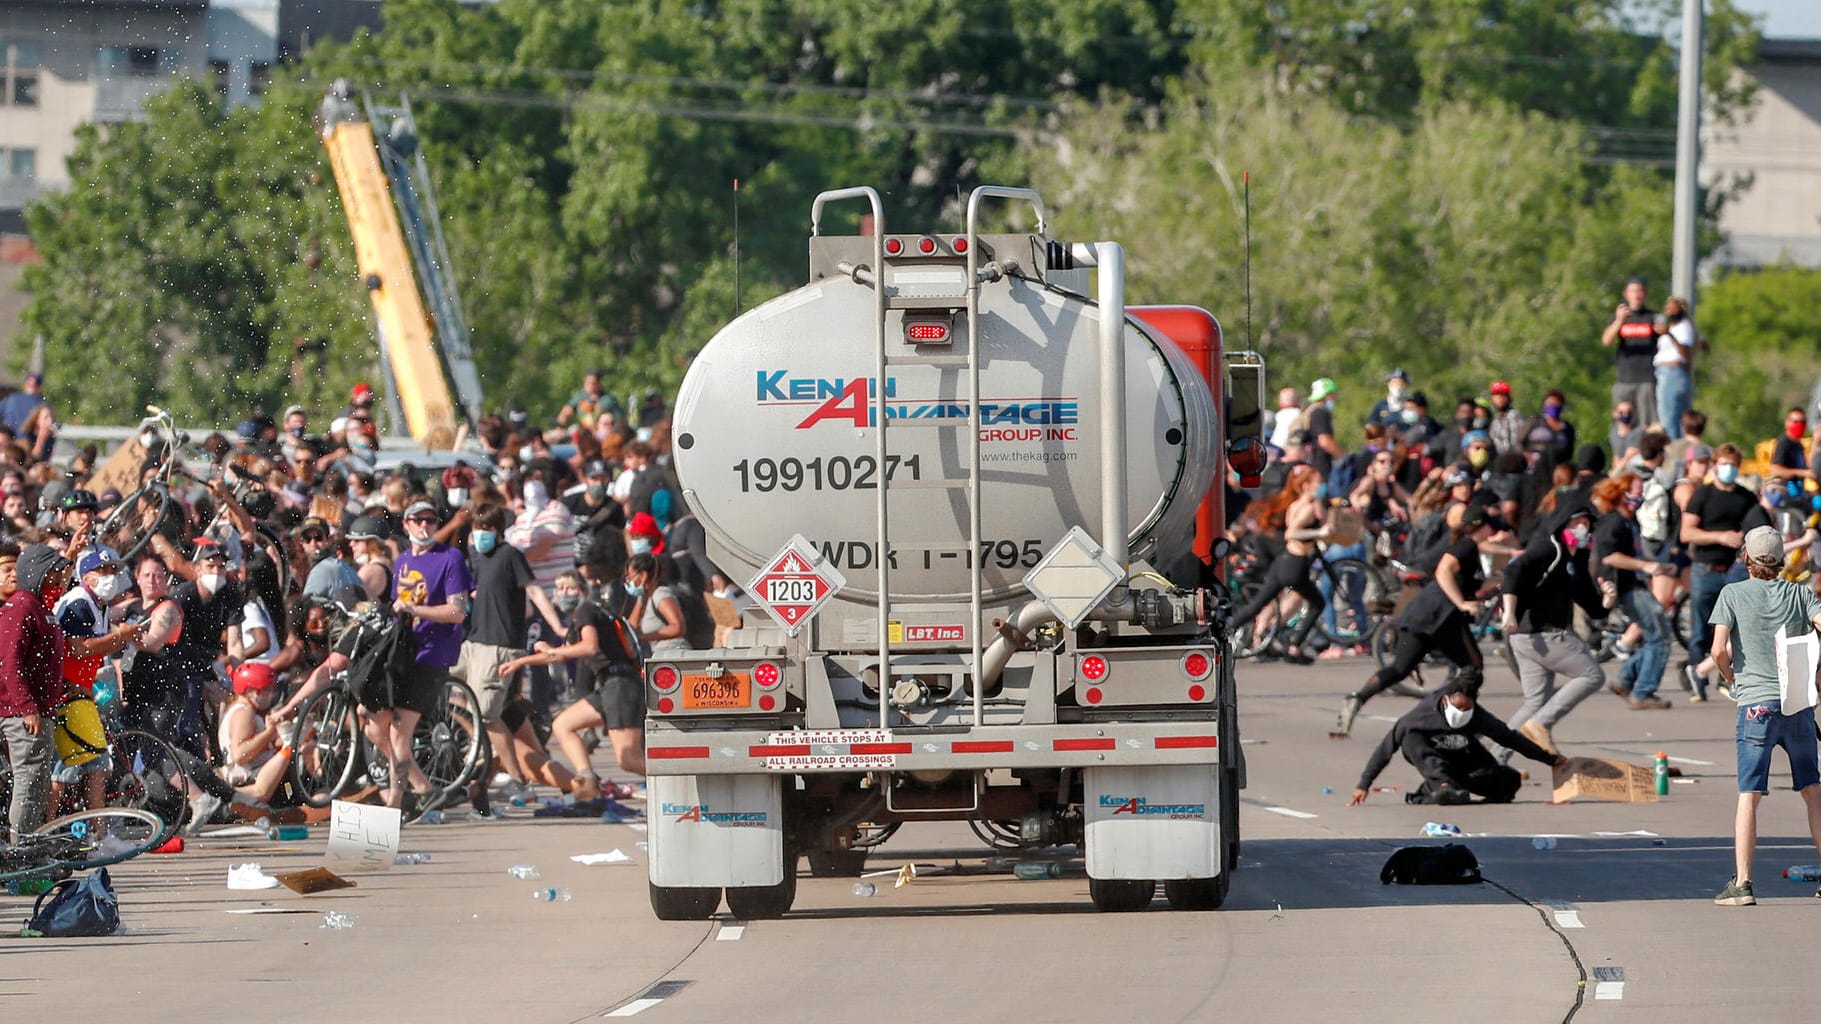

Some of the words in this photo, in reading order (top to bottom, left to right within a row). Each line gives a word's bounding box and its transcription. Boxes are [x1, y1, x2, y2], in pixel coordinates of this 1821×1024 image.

[979, 428, 1042, 442] GROUP,
[1047, 428, 1078, 441] INC.
[981, 450, 1077, 463] www.thekag.com
[733, 454, 920, 492] 19910271
[770, 581, 813, 600] 1203
[787, 608, 797, 619] 3
[937, 629, 962, 639] Inc.
[693, 681, 739, 699] 696396
[775, 737, 799, 745] THIS
[841, 735, 871, 743] STOPS
[769, 757, 786, 765] ALL
[789, 756, 836, 765] RAILROAD
[839, 755, 893, 764] CROSSINGS
